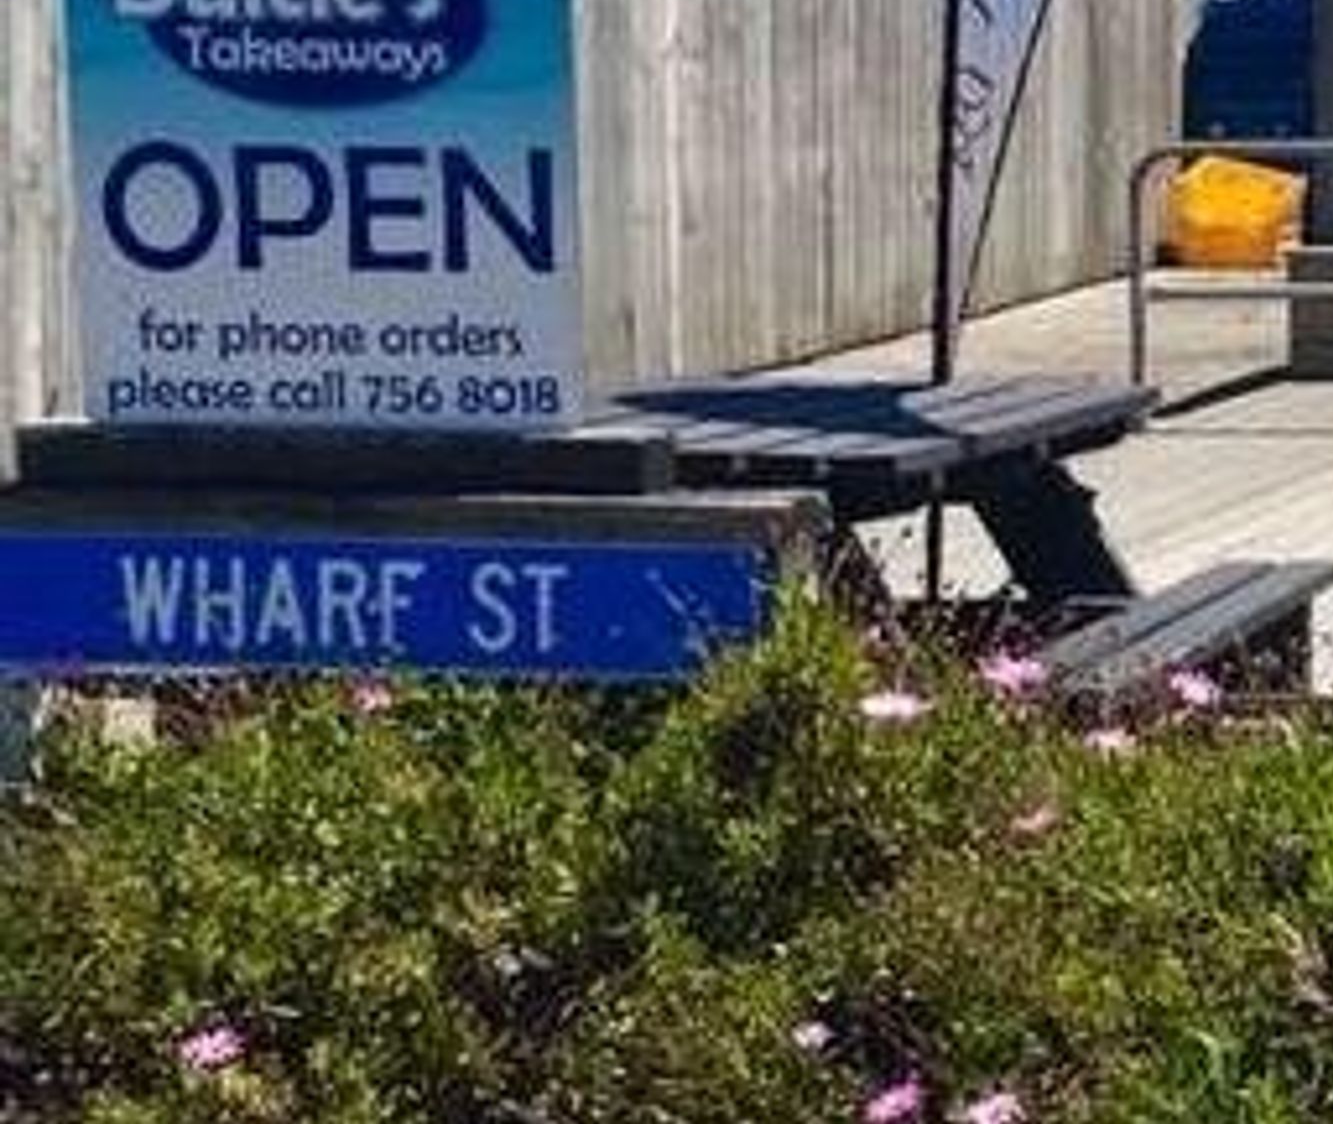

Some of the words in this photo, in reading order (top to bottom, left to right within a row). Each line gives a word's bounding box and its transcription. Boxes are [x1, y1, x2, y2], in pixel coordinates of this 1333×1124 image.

[177, 24, 449, 82] Takeaways
[102, 140, 556, 273] OPEN
[138, 309, 201, 354] for
[217, 310, 366, 374] phone
[379, 311, 524, 356] orders
[107, 367, 253, 427] please
[268, 372, 345, 411] call
[360, 375, 442, 414] 756
[456, 377, 560, 416] 8018
[120, 555, 427, 651] WHARF
[467, 564, 569, 653] ST
